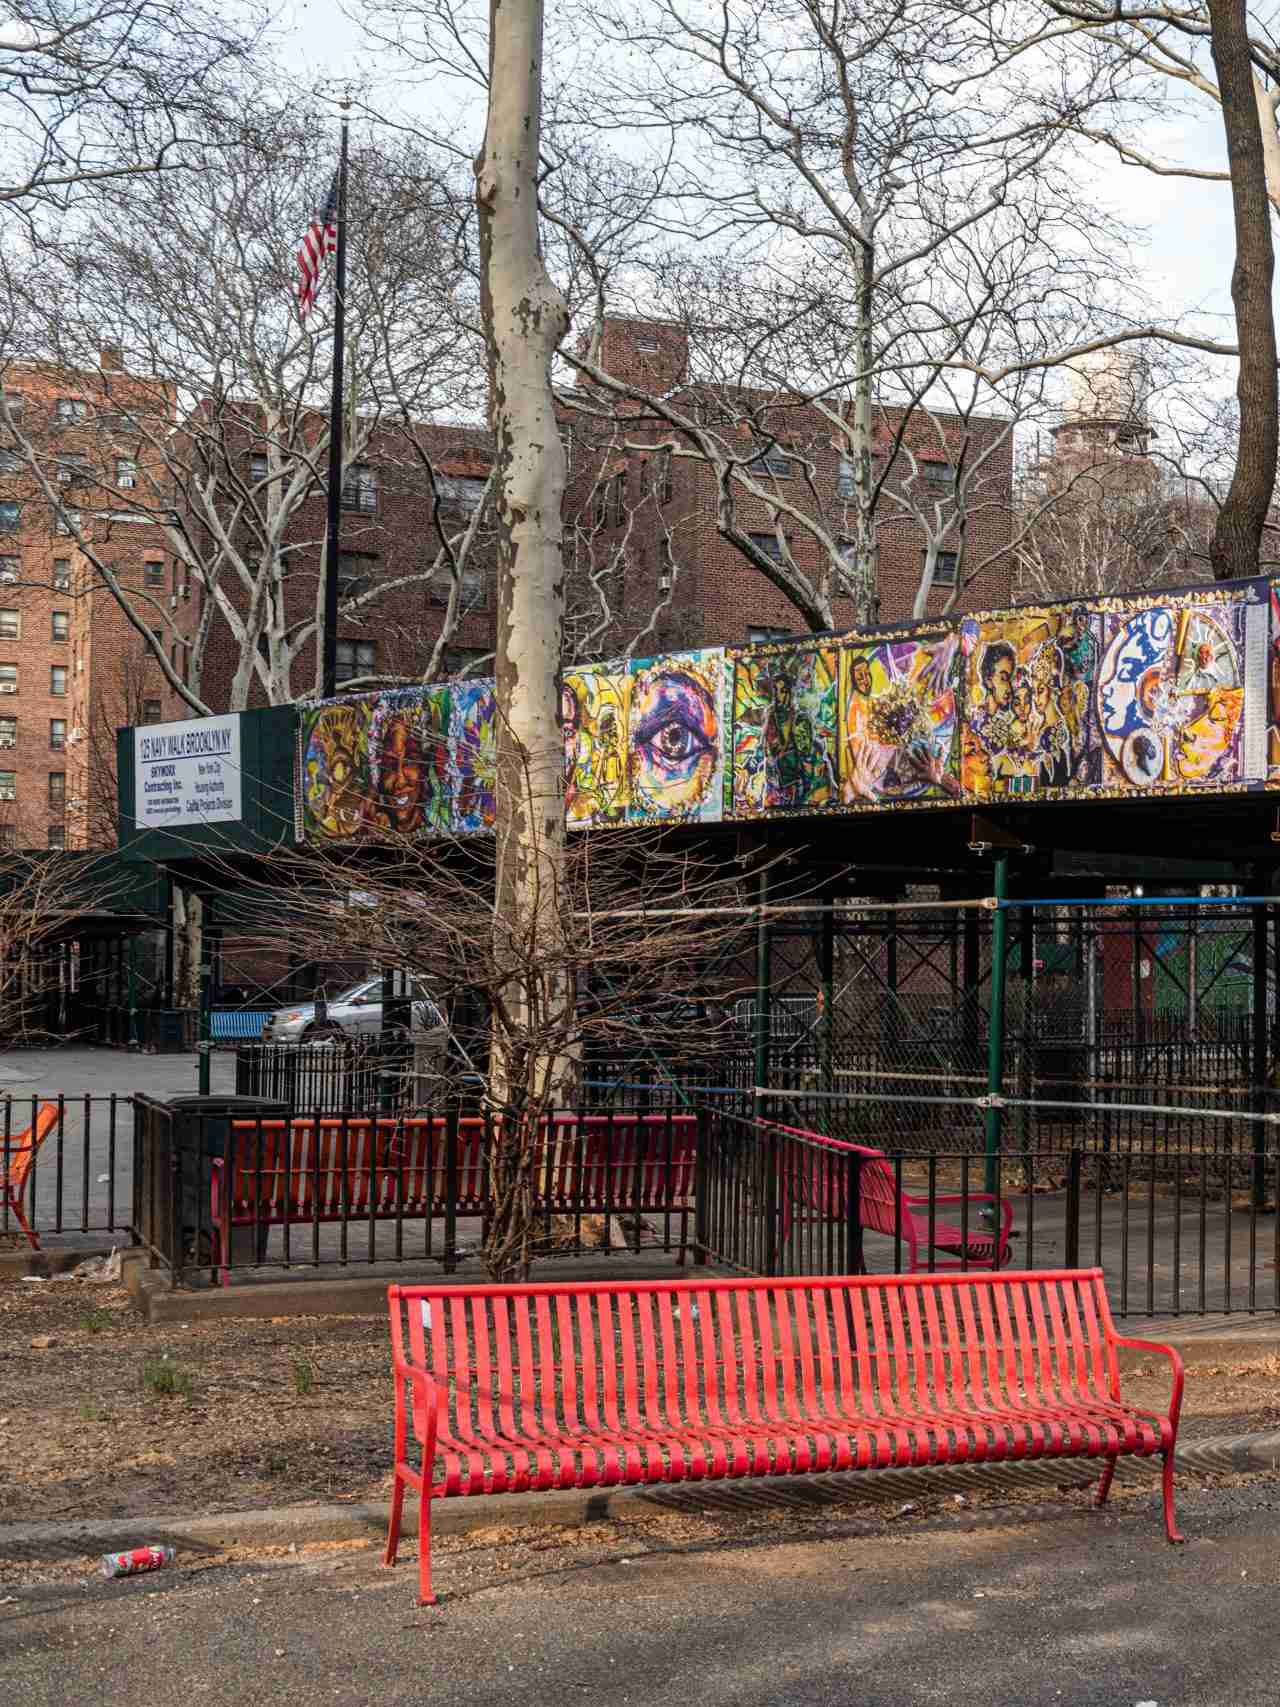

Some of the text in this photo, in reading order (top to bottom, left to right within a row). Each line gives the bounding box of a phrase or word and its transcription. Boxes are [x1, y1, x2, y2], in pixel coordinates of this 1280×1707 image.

[151, 736, 167, 758] NAVY
[168, 734, 185, 756] WALK
[187, 729, 221, 754] BROOKLYN
[222, 728, 231, 751] NY
